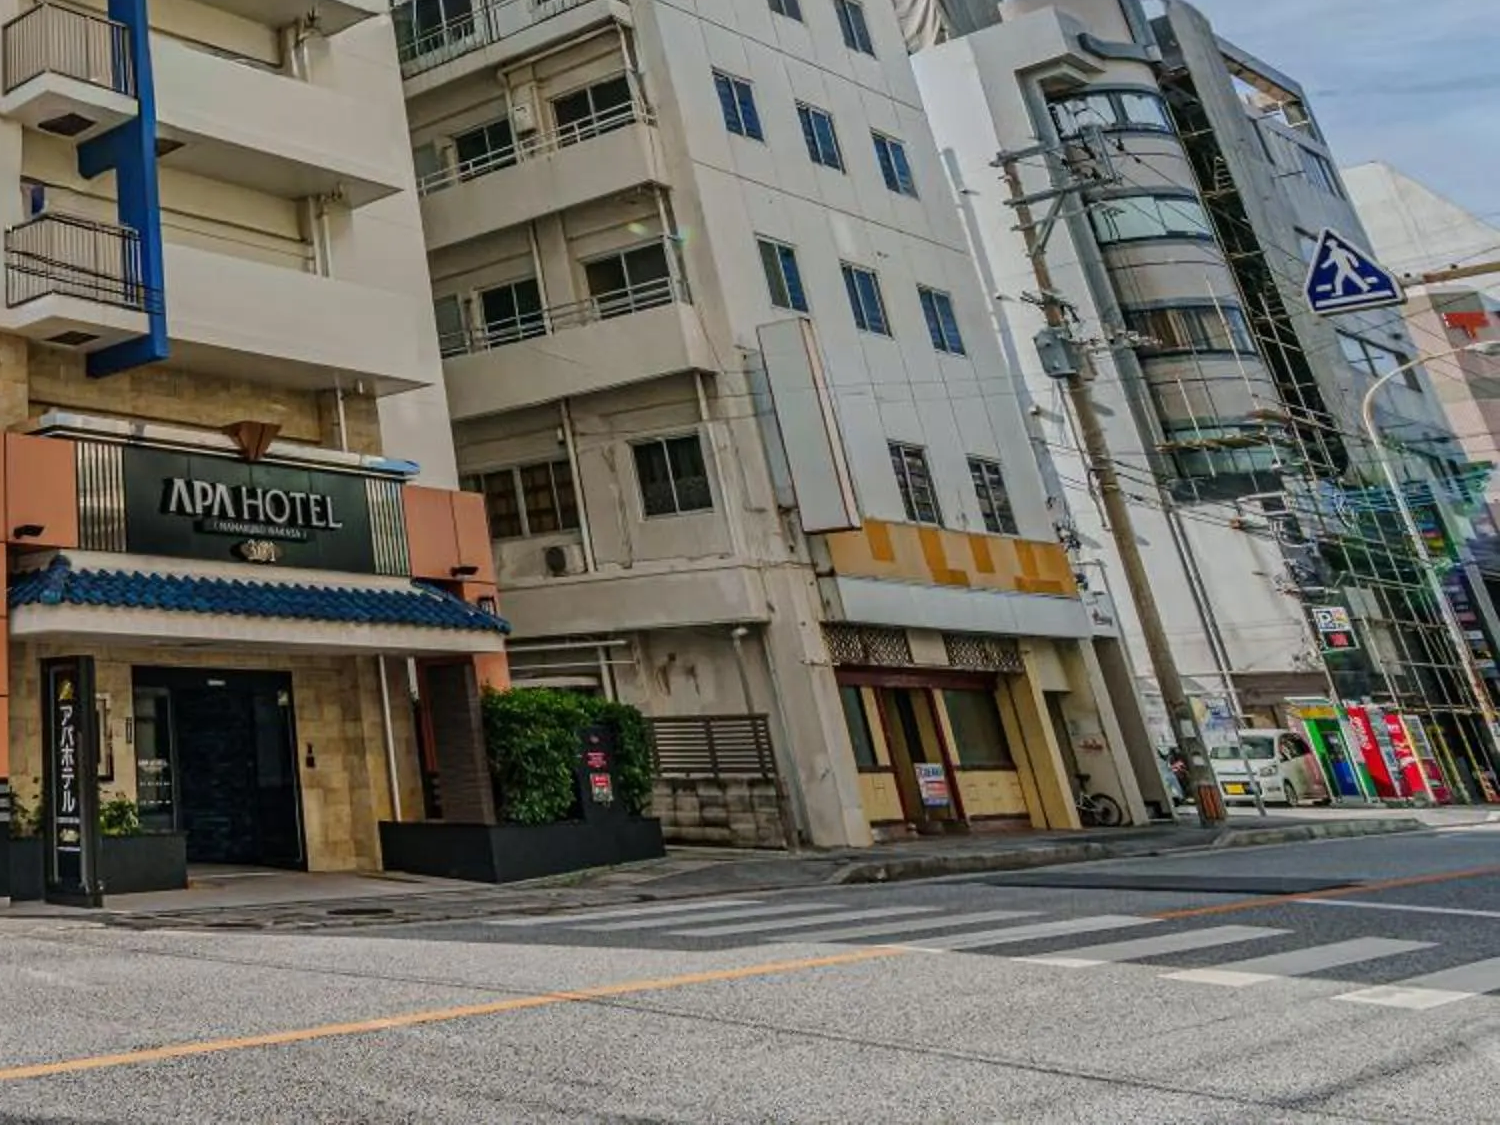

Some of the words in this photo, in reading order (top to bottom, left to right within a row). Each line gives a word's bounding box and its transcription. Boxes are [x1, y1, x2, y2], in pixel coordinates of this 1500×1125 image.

[169, 478, 236, 518] APA
[241, 486, 343, 529] HOTEL
[59, 705, 76, 814] アパホテル
